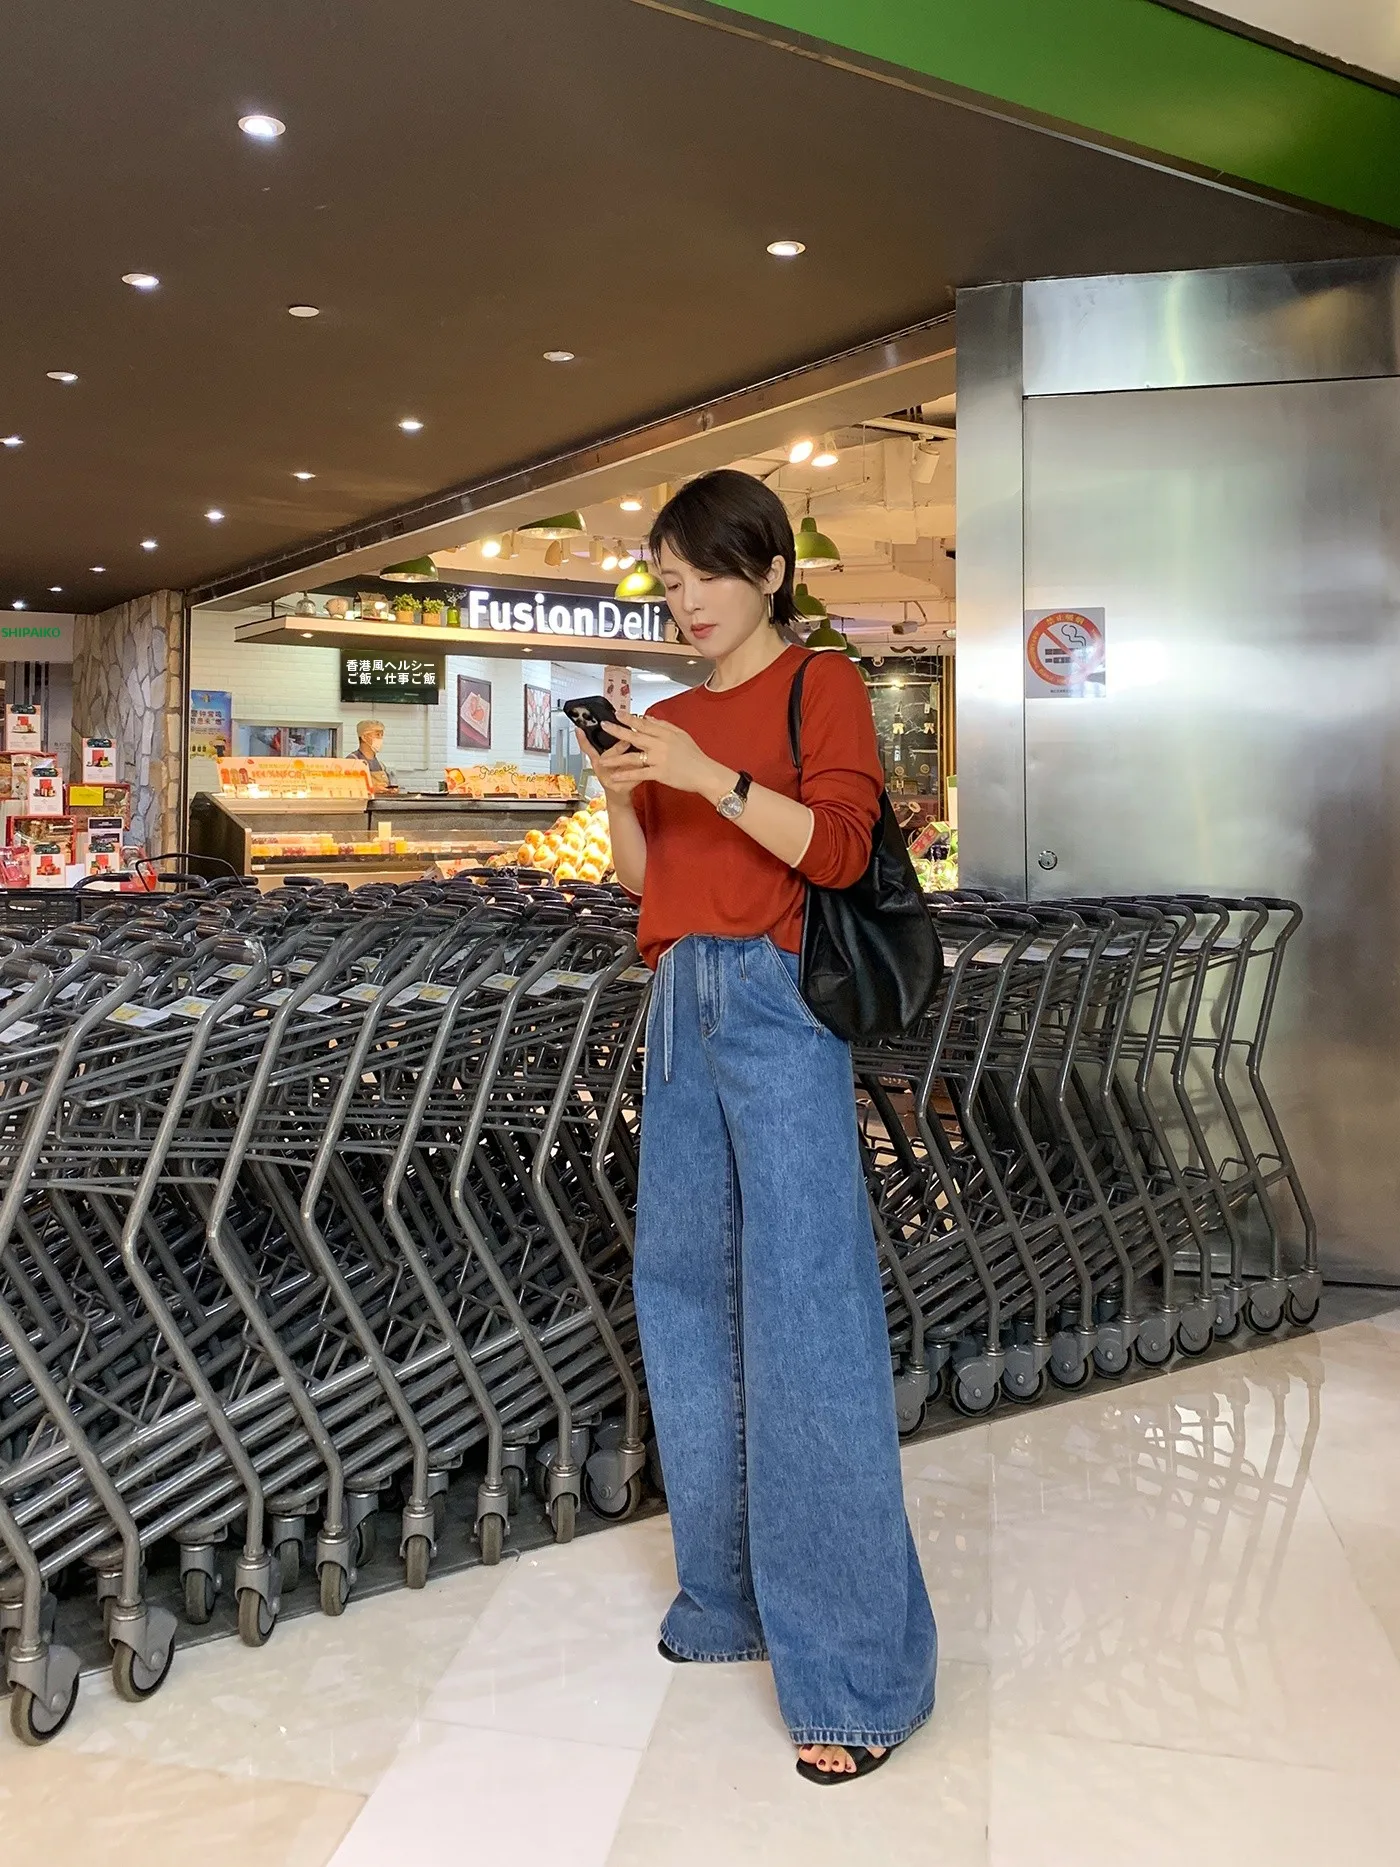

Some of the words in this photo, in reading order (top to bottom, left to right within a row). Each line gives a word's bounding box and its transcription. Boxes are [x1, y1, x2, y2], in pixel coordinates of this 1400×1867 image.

[1, 626, 61, 638] SHIPAIKO
[346, 659, 435, 672] 香港風ヘルシー
[347, 672, 436, 685] ご飯・仕事ご飯
